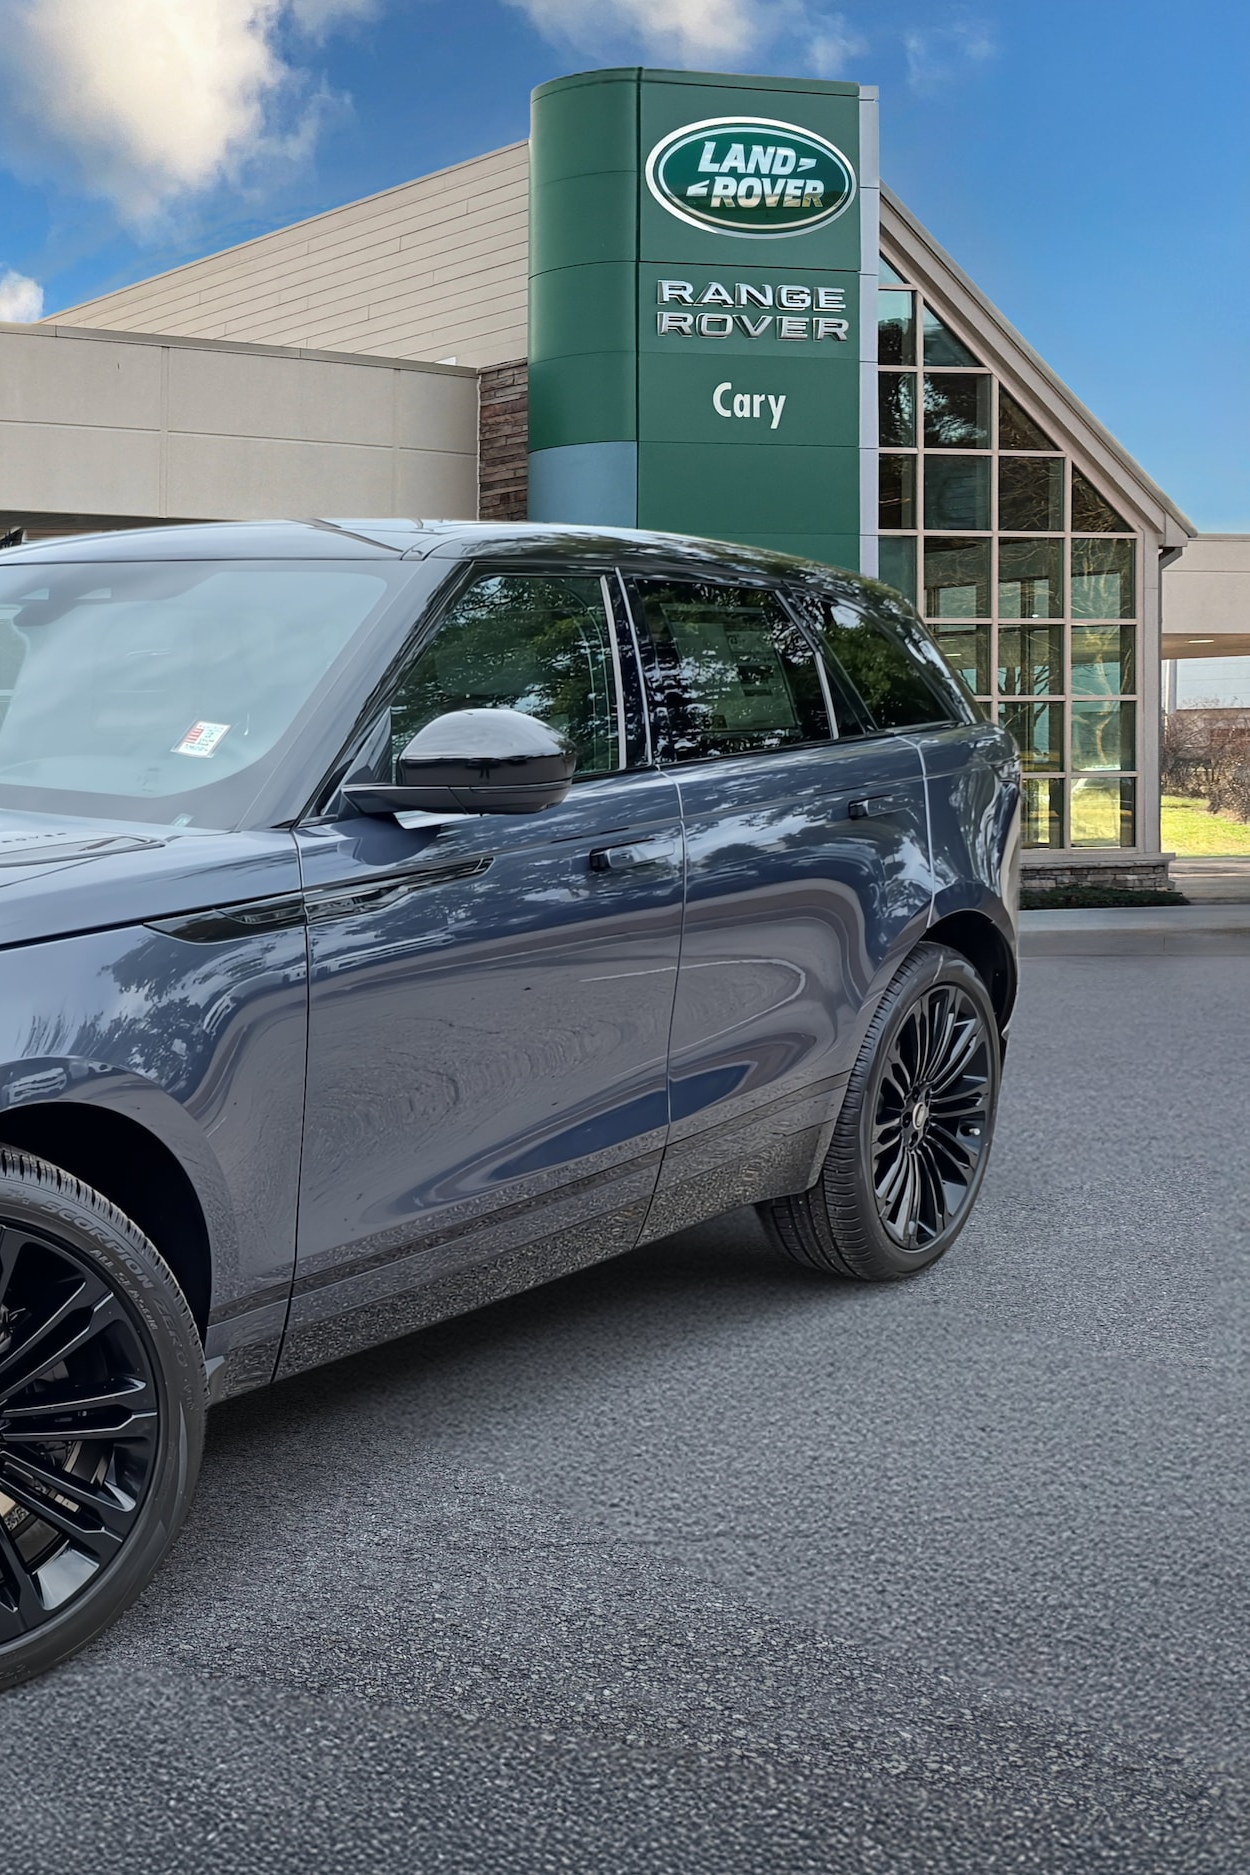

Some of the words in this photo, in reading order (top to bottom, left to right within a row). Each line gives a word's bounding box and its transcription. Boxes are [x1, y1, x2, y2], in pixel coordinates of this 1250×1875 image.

[697, 141, 796, 174] LAND
[710, 176, 825, 208] ROVER
[656, 279, 847, 312] RANGE
[656, 311, 850, 342] ROVER
[712, 382, 787, 430] Cary
[39, 1200, 155, 1289] SCORPION
